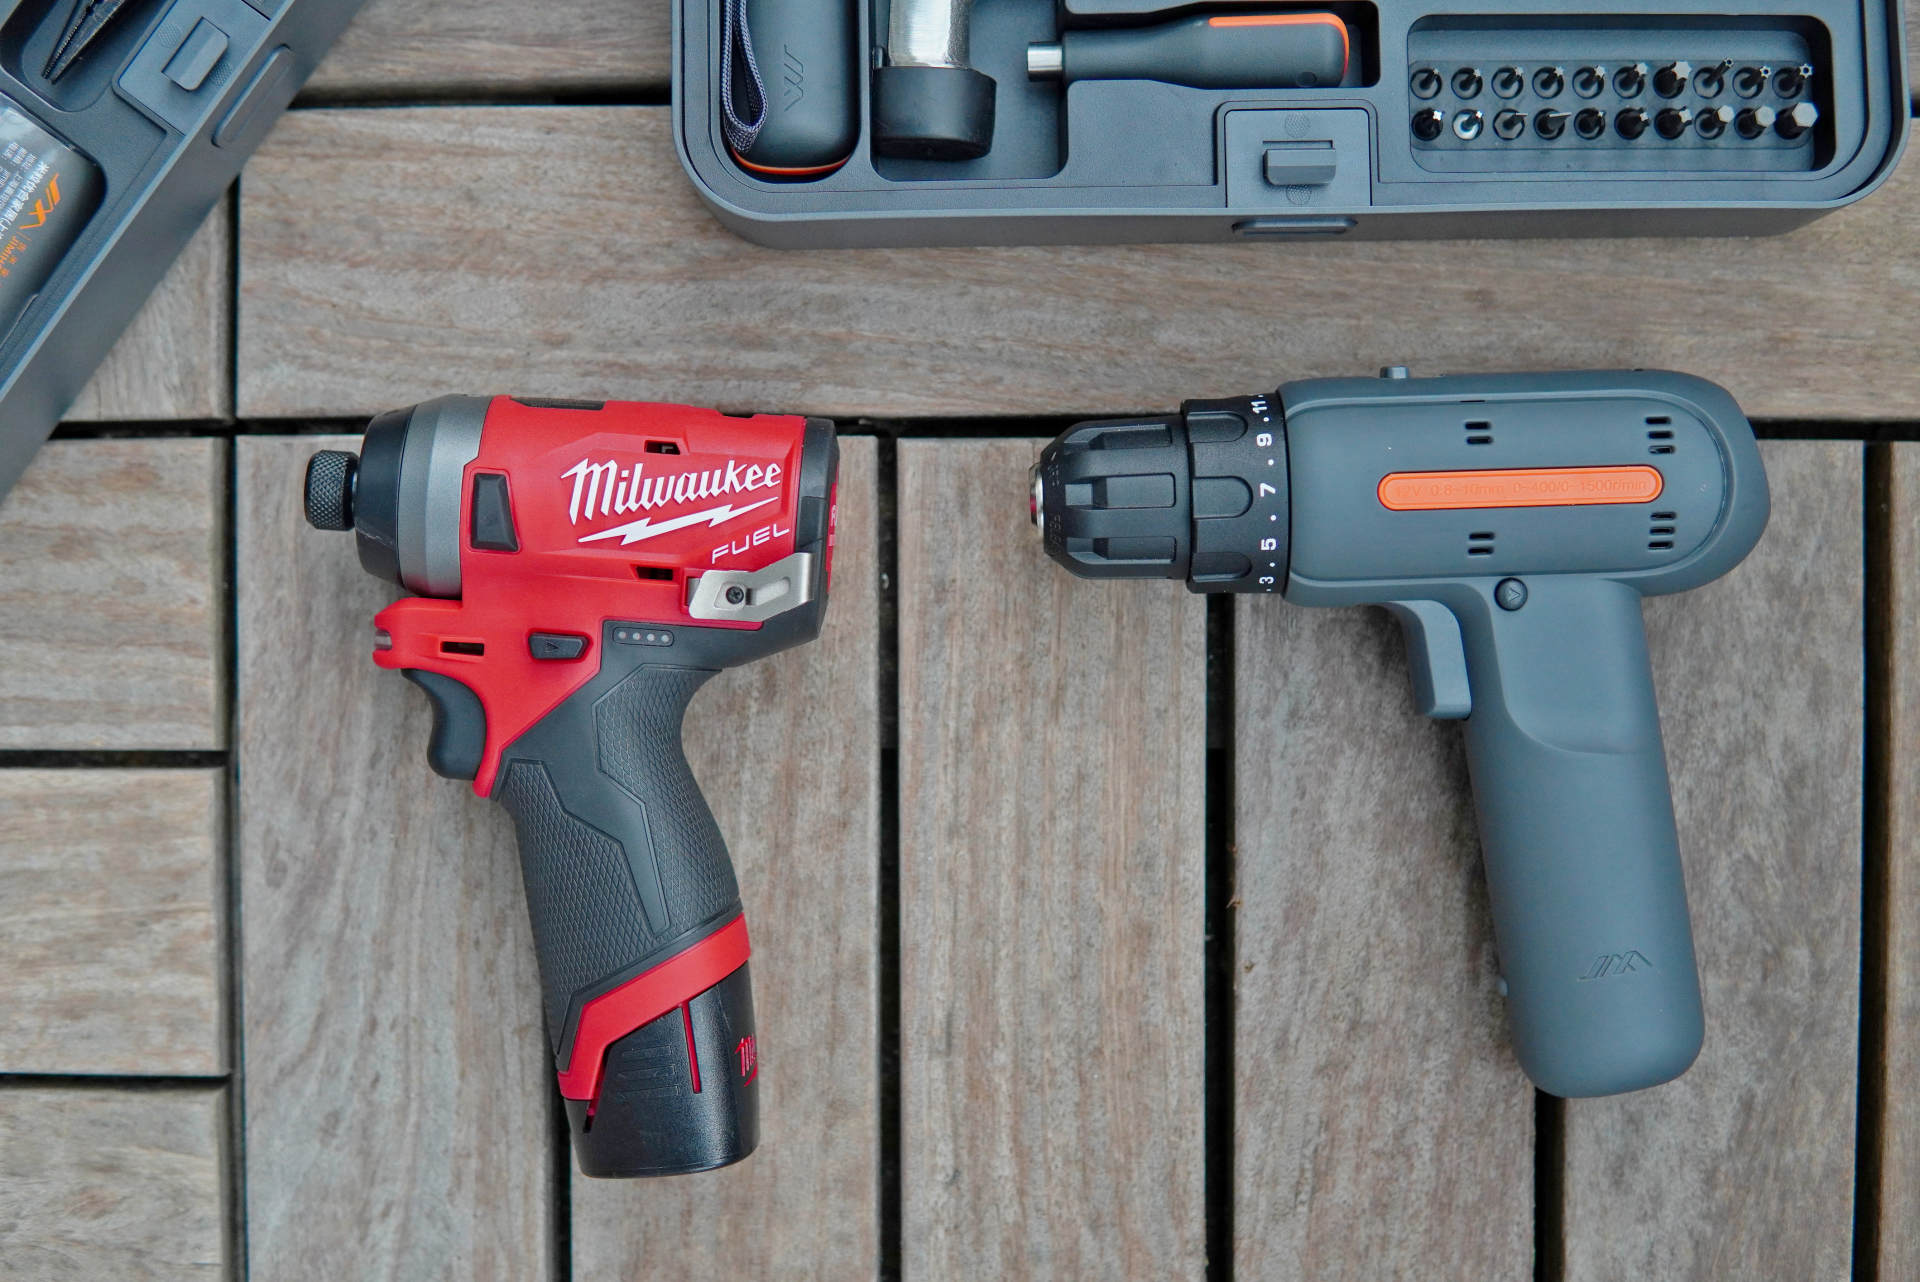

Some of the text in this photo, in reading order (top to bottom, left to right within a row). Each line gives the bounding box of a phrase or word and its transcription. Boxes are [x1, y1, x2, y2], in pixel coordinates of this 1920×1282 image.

[1251, 400, 1268, 414] 11
[1256, 433, 1273, 447] 9
[560, 458, 781, 525] Milwaukee
[1259, 483, 1276, 497] 7
[711, 523, 789, 564] FUEL
[1260, 538, 1277, 551] 5
